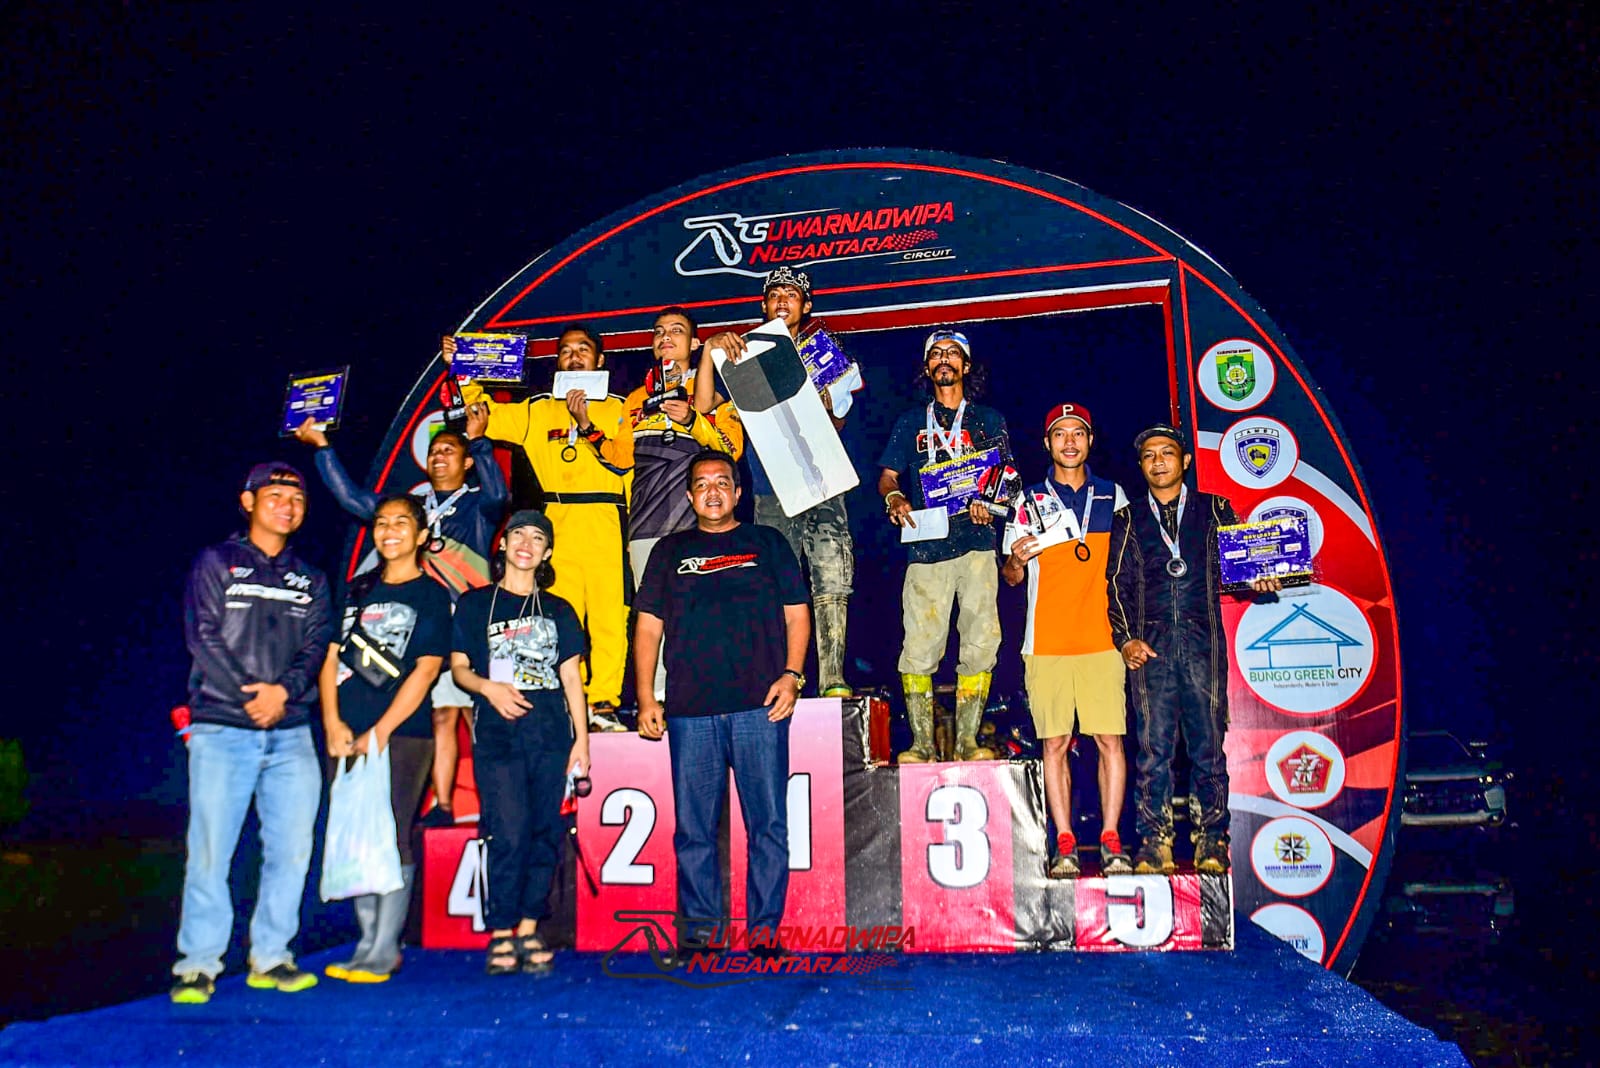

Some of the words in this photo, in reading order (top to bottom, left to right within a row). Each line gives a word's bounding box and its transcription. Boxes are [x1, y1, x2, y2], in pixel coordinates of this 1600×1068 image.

[742, 201, 954, 243] SUWARNADWIPA
[749, 233, 895, 265] NUSANTARA
[903, 249, 951, 260] CIRCUIT
[1062, 404, 1074, 417] P
[1240, 428, 1274, 436] JAMBI
[1249, 670, 1291, 682] BUNGO
[1294, 668, 1335, 680] GREEN
[1337, 667, 1363, 679] CITY
[599, 787, 656, 885] 2
[925, 785, 992, 889] 3
[447, 838, 488, 932] 4
[1105, 874, 1175, 947] 5
